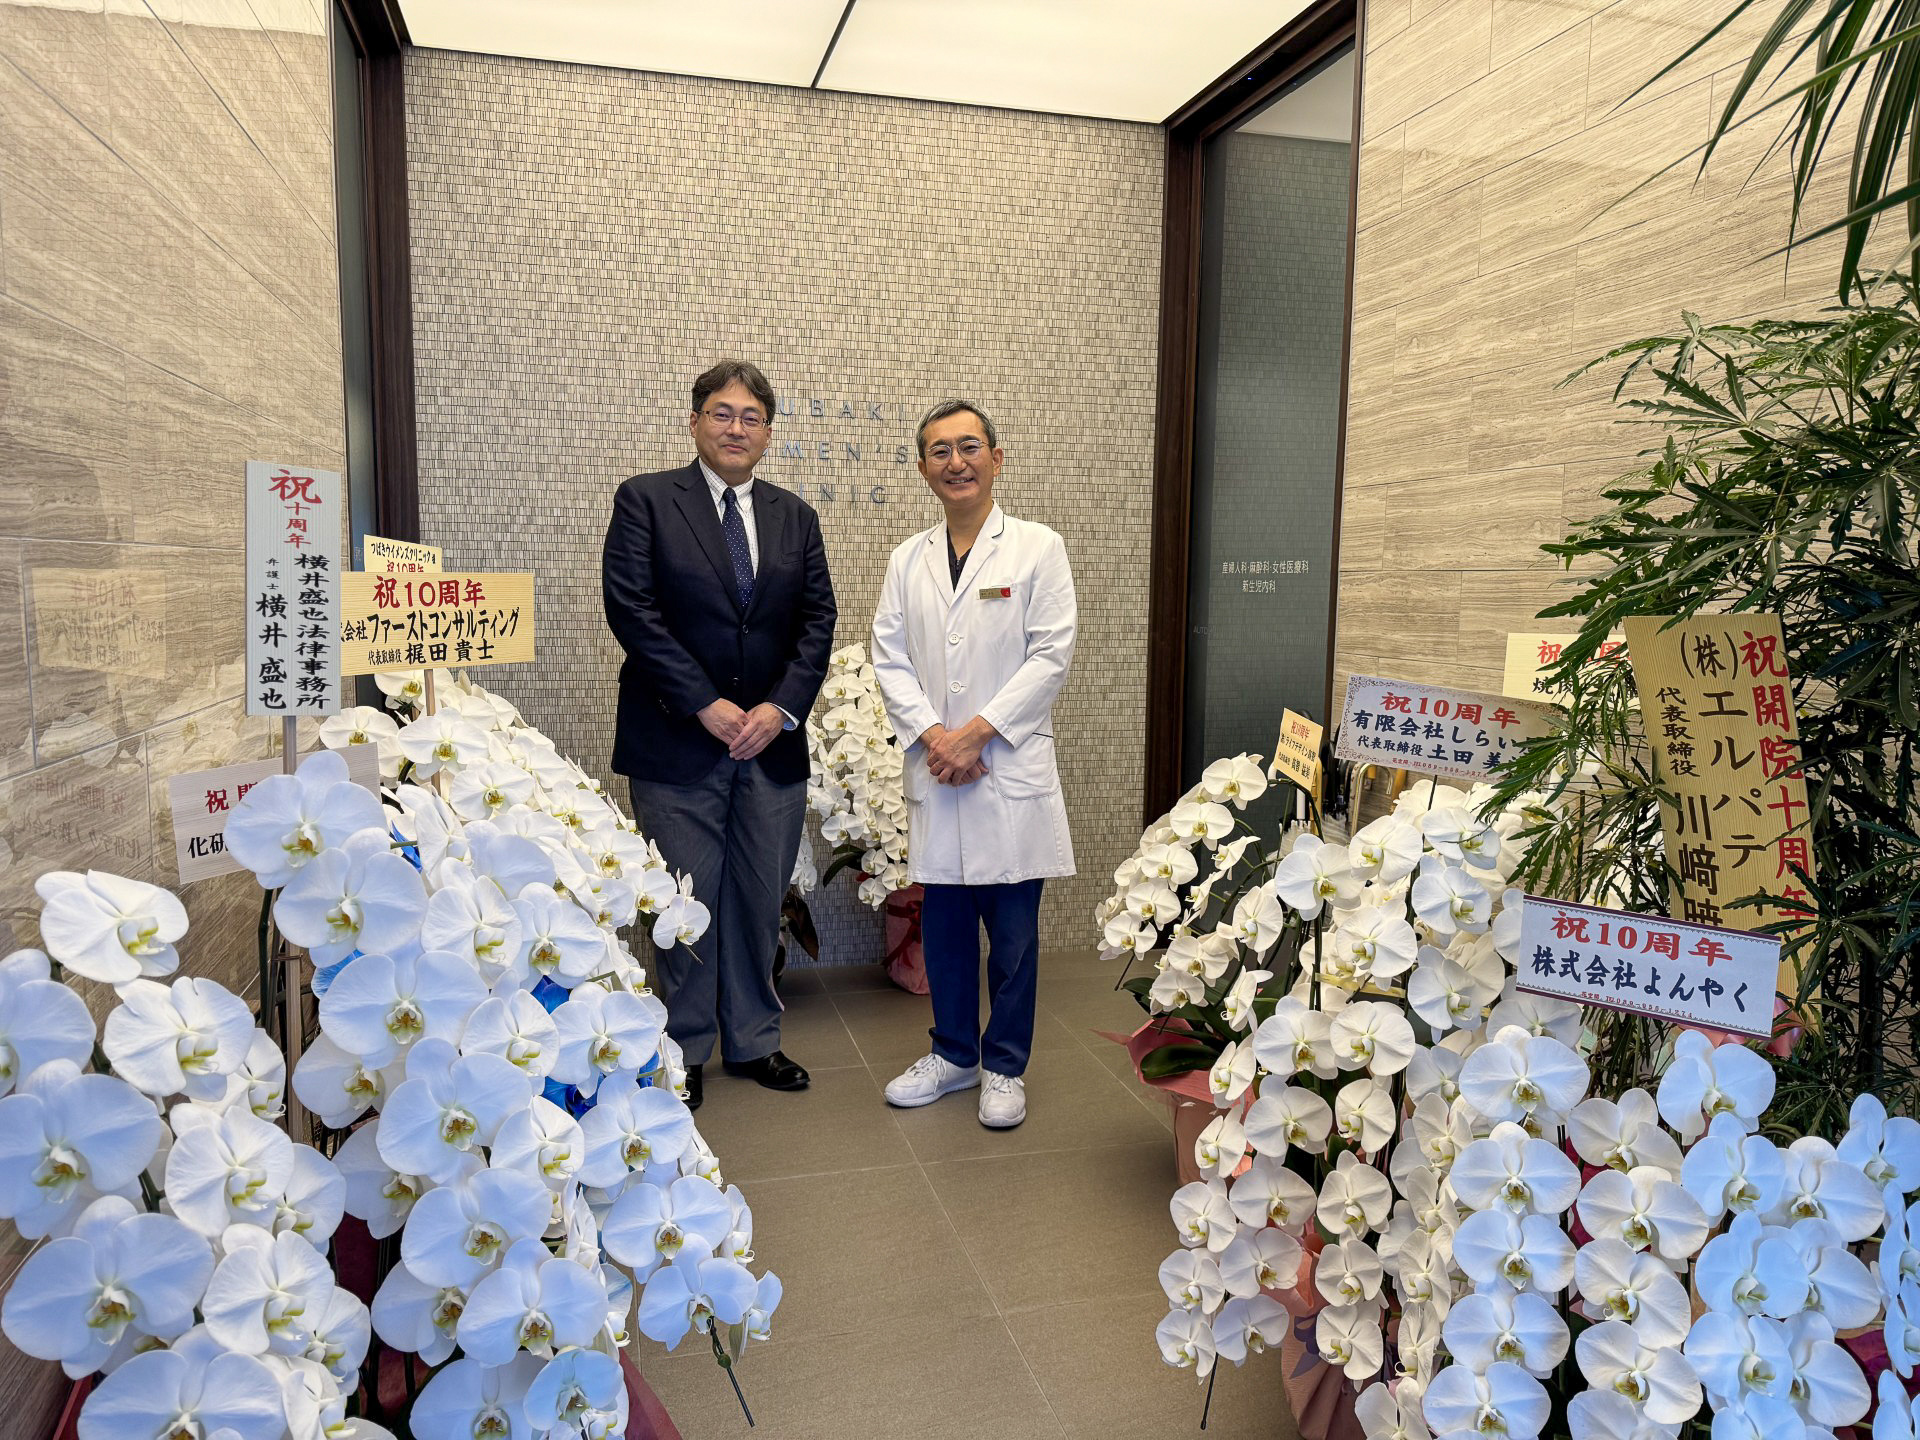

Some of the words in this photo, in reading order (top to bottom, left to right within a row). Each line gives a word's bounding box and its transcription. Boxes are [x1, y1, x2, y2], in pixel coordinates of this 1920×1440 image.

[372, 575, 486, 609] 祝10周年
[294, 553, 333, 710] 横井盛也法律事務所
[1351, 709, 1541, 754] 有限会社しらい
[1380, 692, 1521, 729] 祝10周年
[1655, 687, 1700, 777] 代表取締役
[1357, 735, 1423, 758] 代表取締役
[1551, 911, 1733, 967] 祝10周年
[1531, 945, 1748, 1013] 株式会社よんやく
